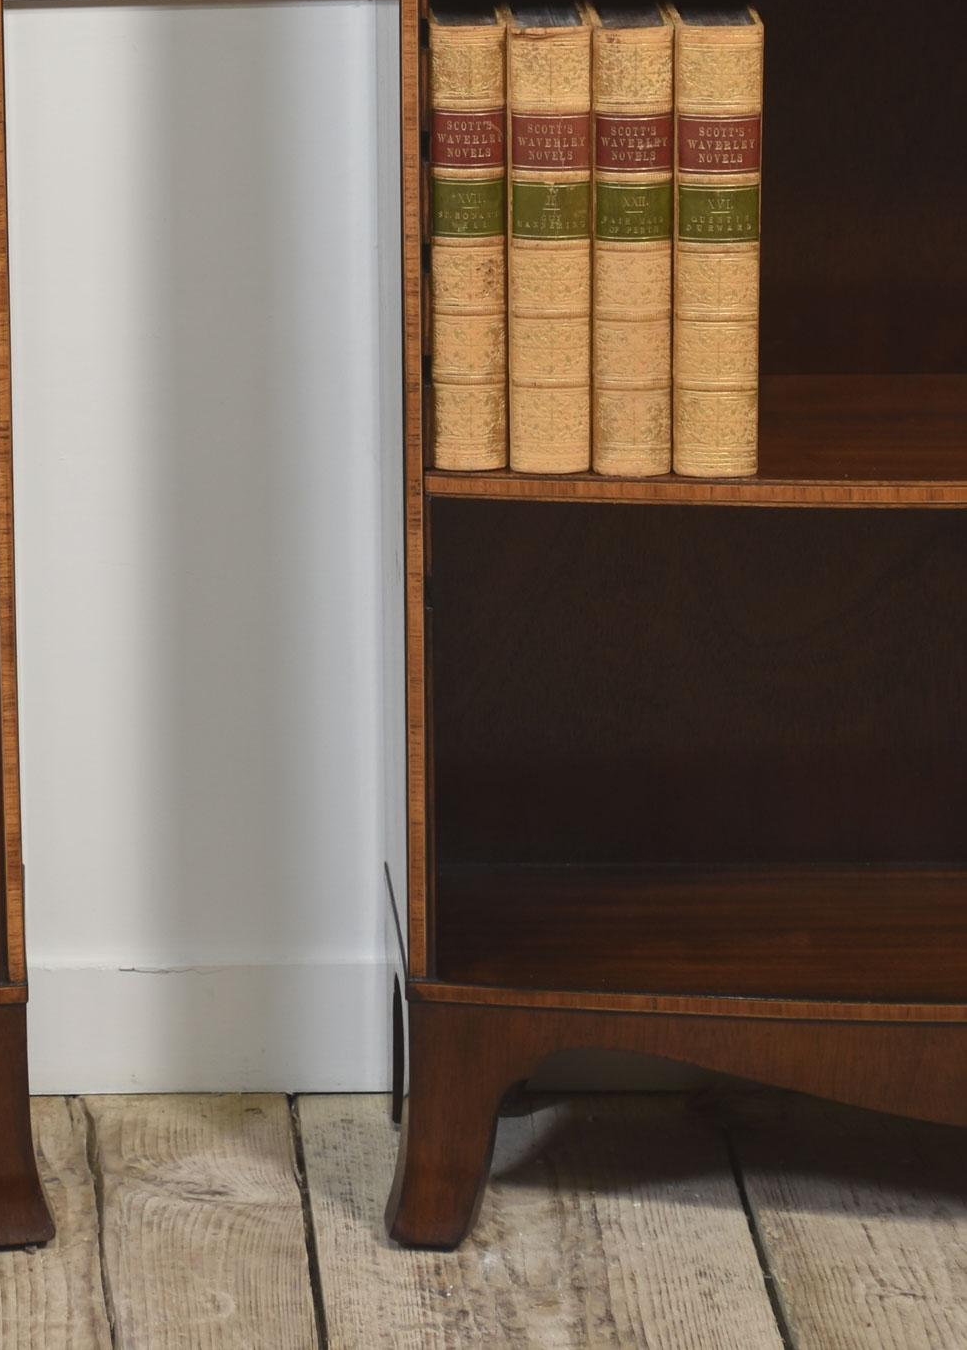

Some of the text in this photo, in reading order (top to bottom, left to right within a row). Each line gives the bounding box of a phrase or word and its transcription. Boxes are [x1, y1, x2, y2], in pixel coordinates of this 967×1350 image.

[447, 121, 492, 130] SCOTT'S
[528, 123, 573, 134] SCOTT'S
[611, 126, 656, 136] SCOTT'S
[699, 127, 744, 137] SCOTT'S
[518, 137, 585, 147] WAVERLEY
[601, 137, 667, 148] WAVERLEY
[688, 139, 755, 150] WAVERLEY
[447, 148, 490, 157] NOVELS
[529, 151, 573, 160] NOVELS
[612, 151, 656, 161] NOVELS
[699, 154, 742, 163] NOVELS
